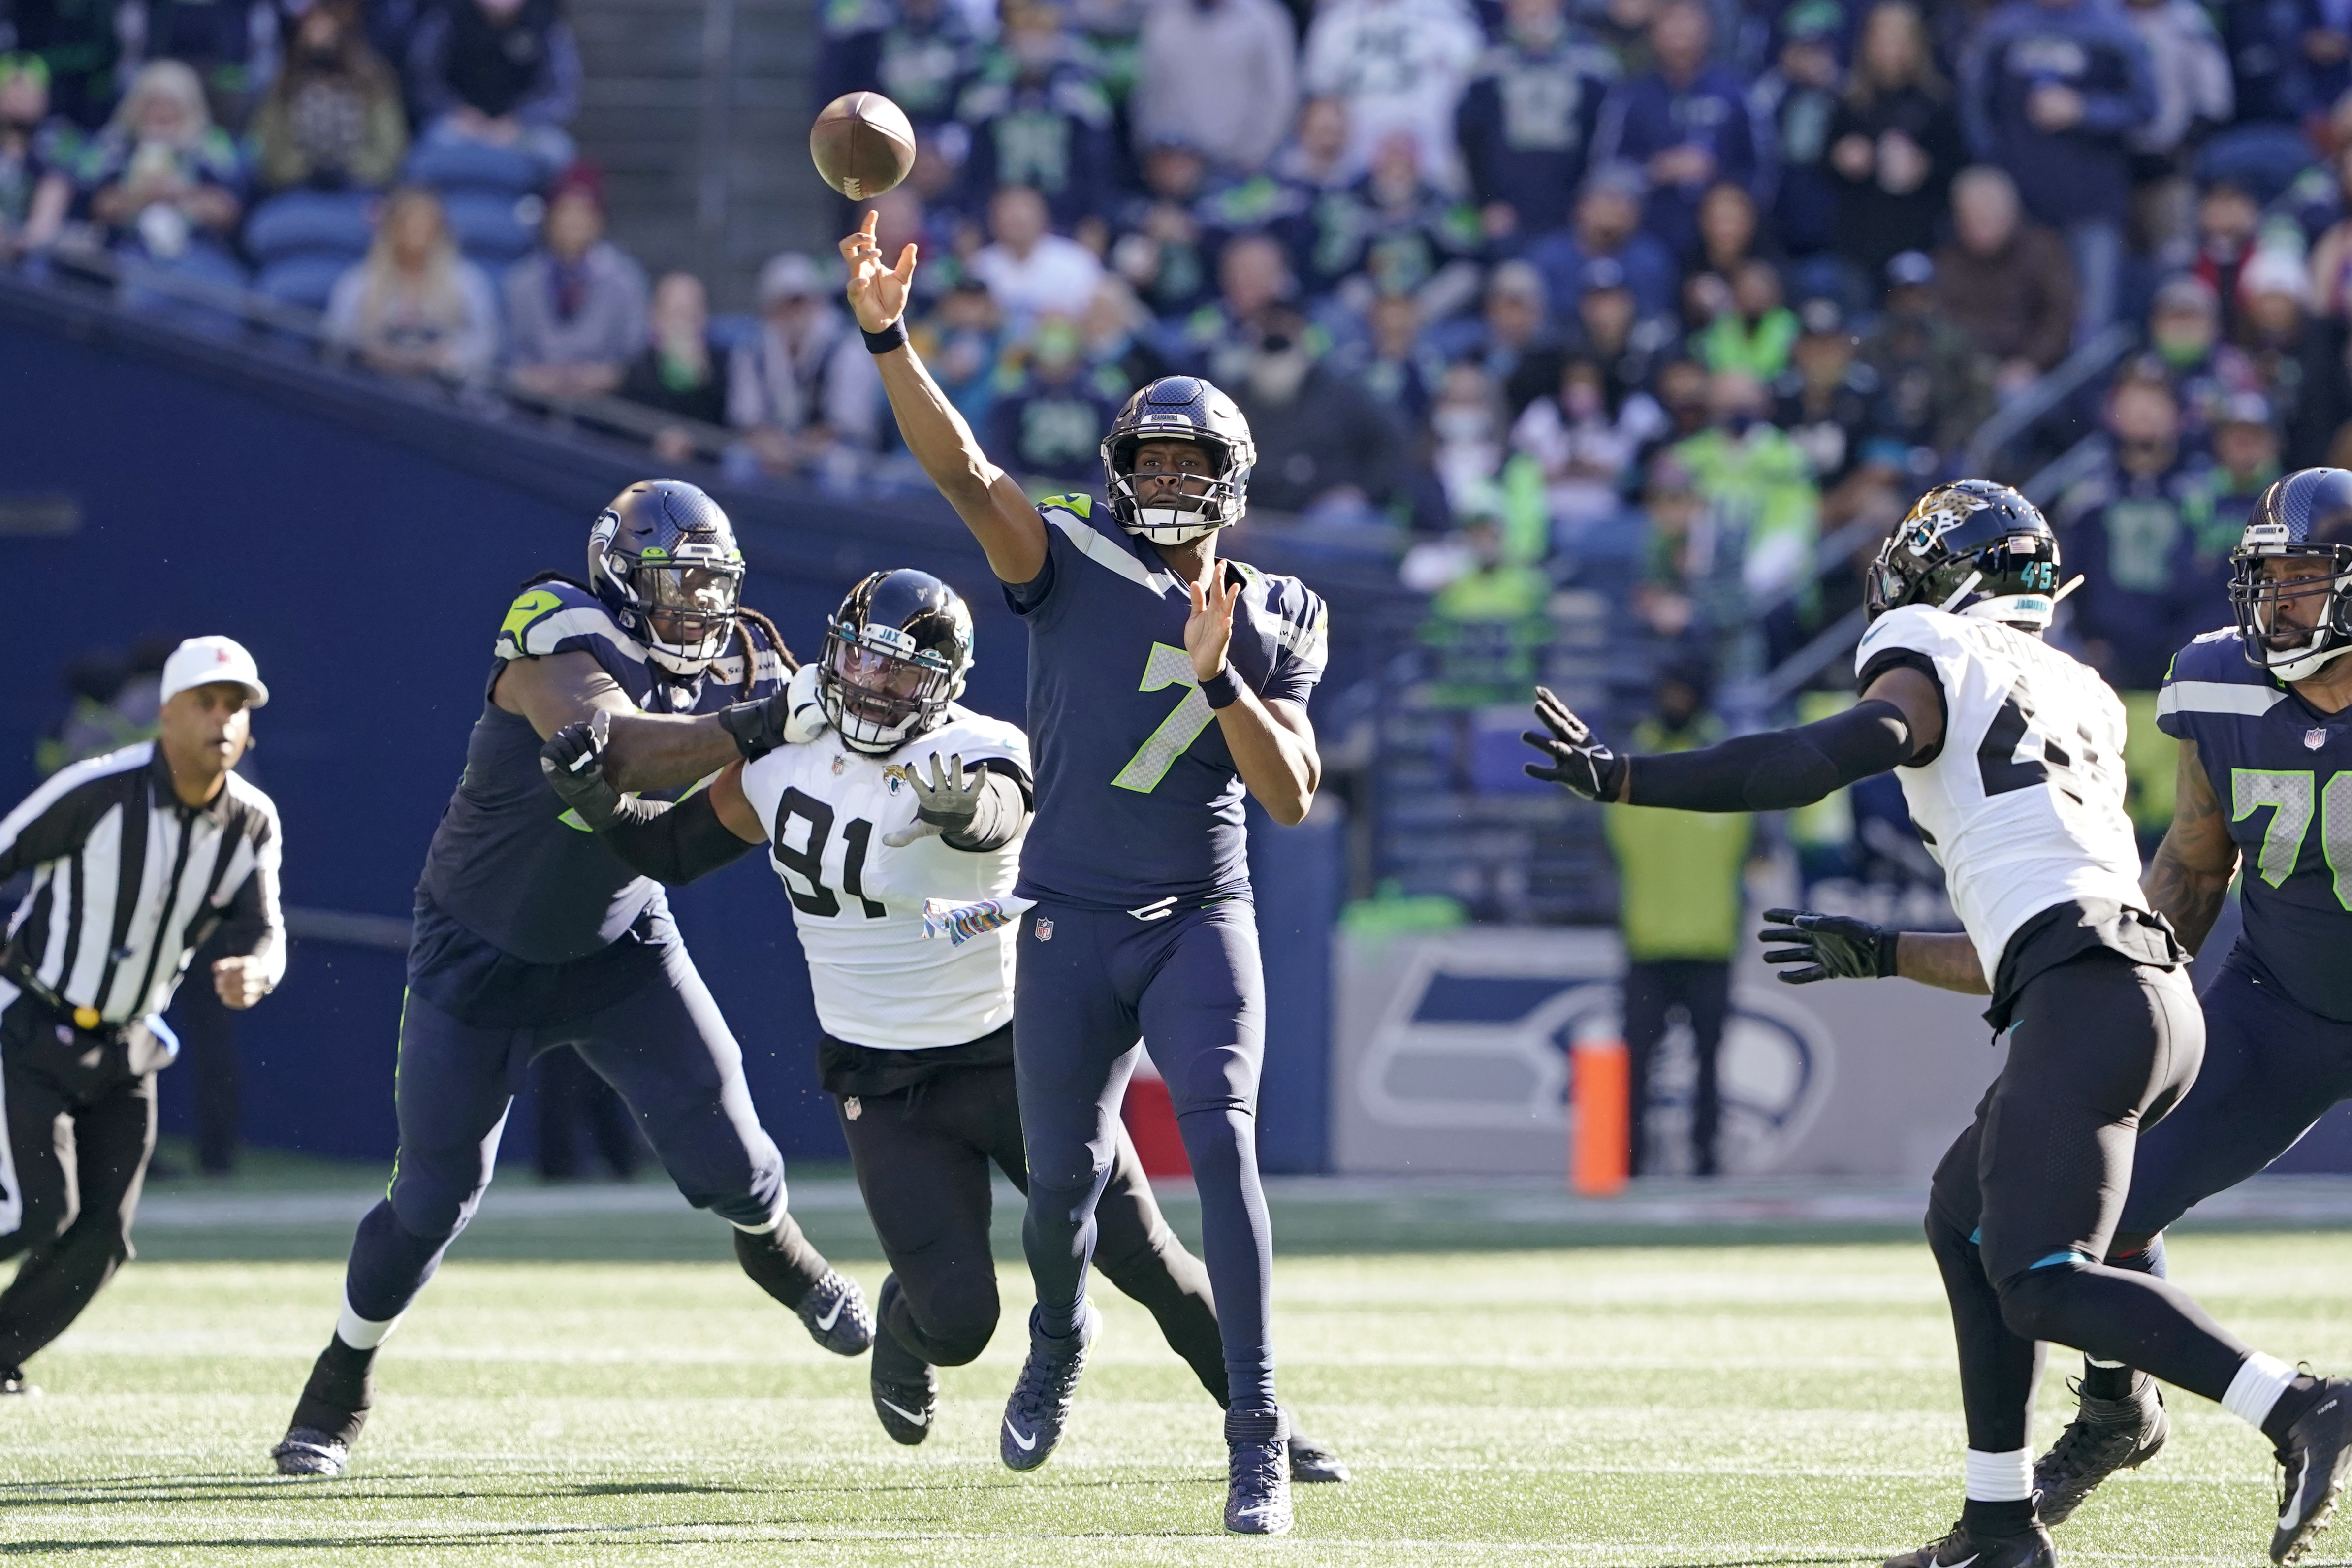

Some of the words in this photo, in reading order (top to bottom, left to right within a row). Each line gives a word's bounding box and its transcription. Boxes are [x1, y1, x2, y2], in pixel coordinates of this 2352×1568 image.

[2020, 561, 2052, 589] 45
[879, 629, 900, 643] JAX
[1111, 641, 1236, 794] 7
[773, 785, 887, 919] 91
[1038, 927, 1049, 937] NFL
